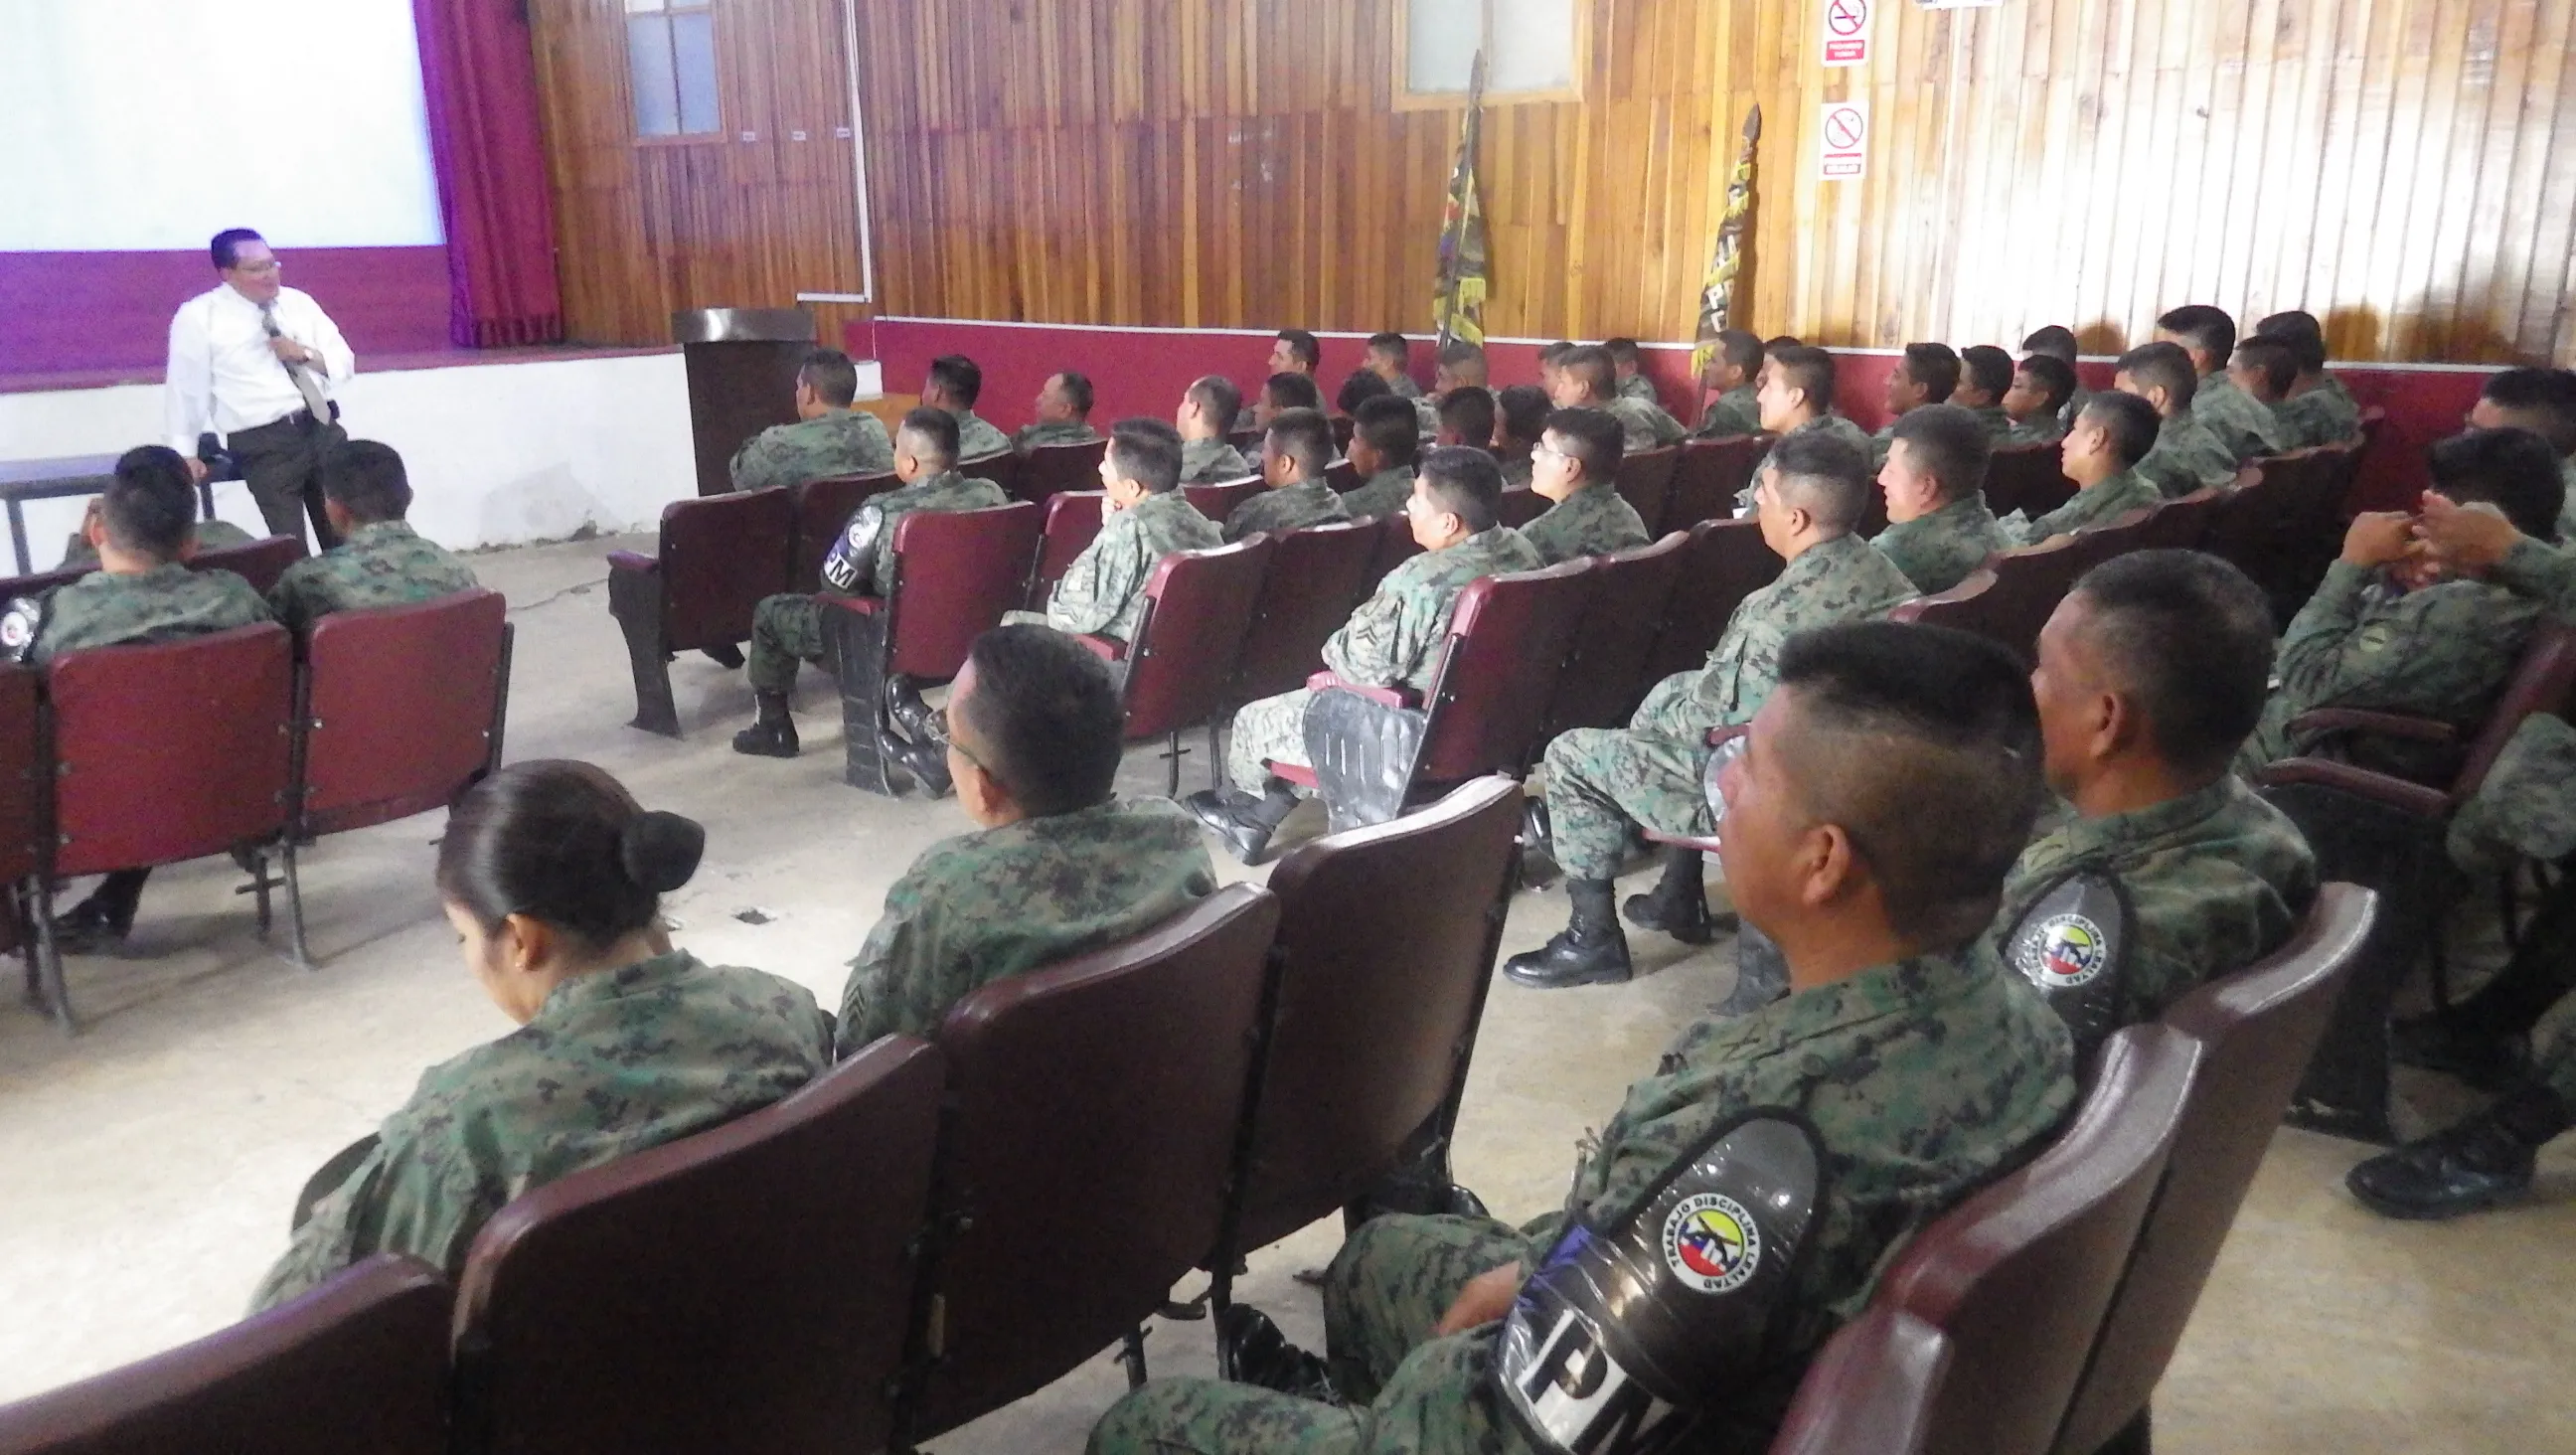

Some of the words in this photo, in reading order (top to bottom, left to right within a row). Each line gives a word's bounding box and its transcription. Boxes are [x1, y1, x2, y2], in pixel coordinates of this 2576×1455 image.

[1667, 1203, 1691, 1268] TRABAJO
[1693, 1196, 1756, 1246] DISCIPLINA
[1703, 1252, 1754, 1289] LEALTAD
